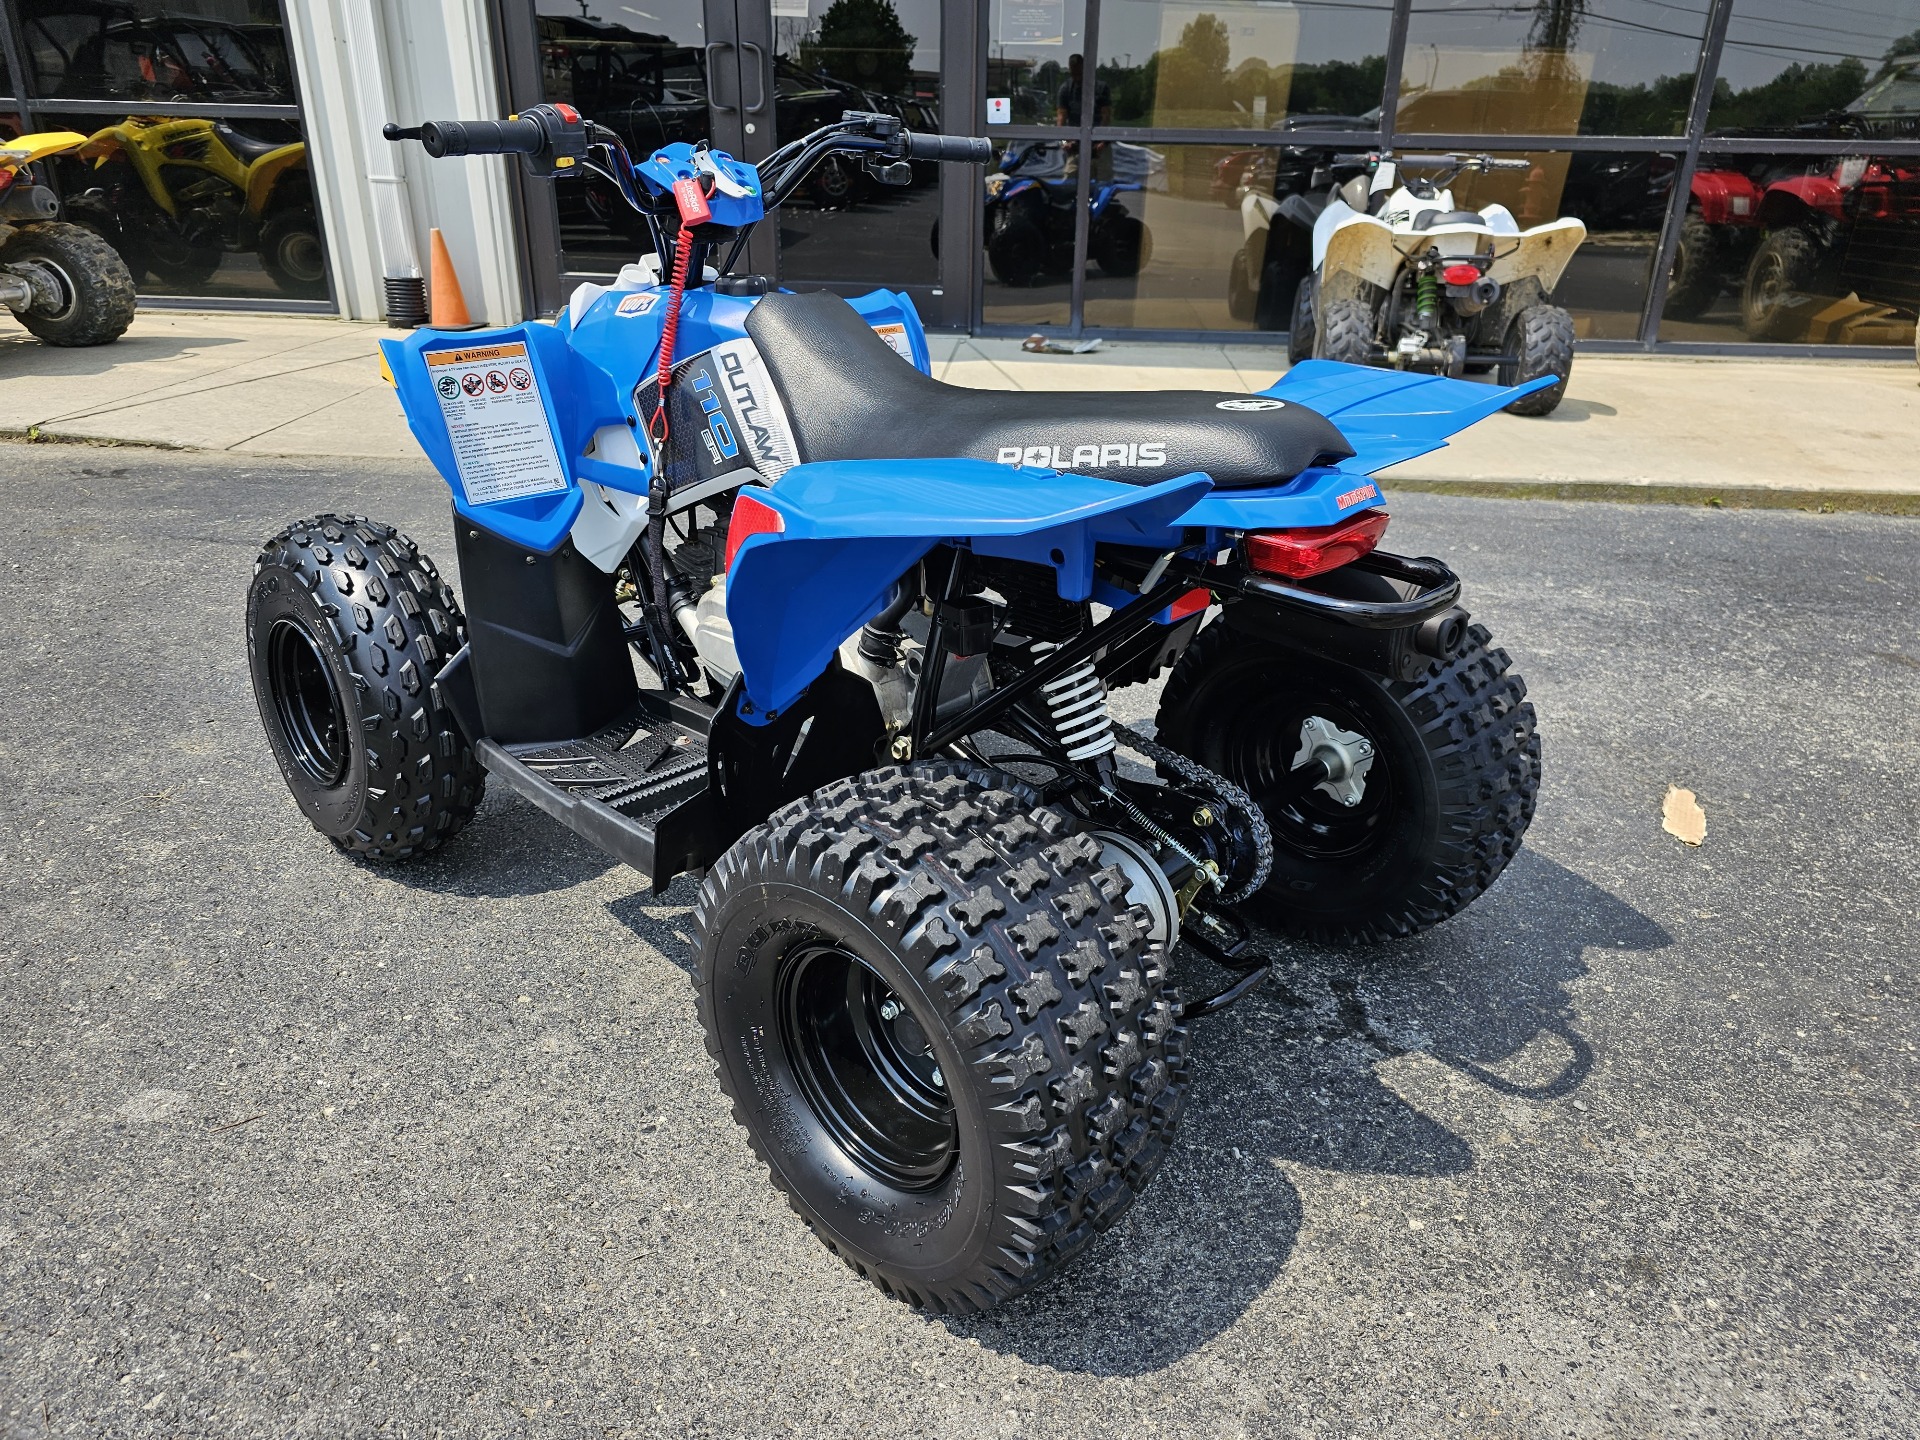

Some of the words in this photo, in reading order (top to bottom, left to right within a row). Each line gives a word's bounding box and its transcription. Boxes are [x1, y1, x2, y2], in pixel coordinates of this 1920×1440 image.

[464, 349, 501, 359] WARNING
[692, 368, 740, 460] 110
[720, 352, 784, 465] OUTLAW
[701, 428, 723, 466] EFI
[997, 443, 1167, 469] POLARIS
